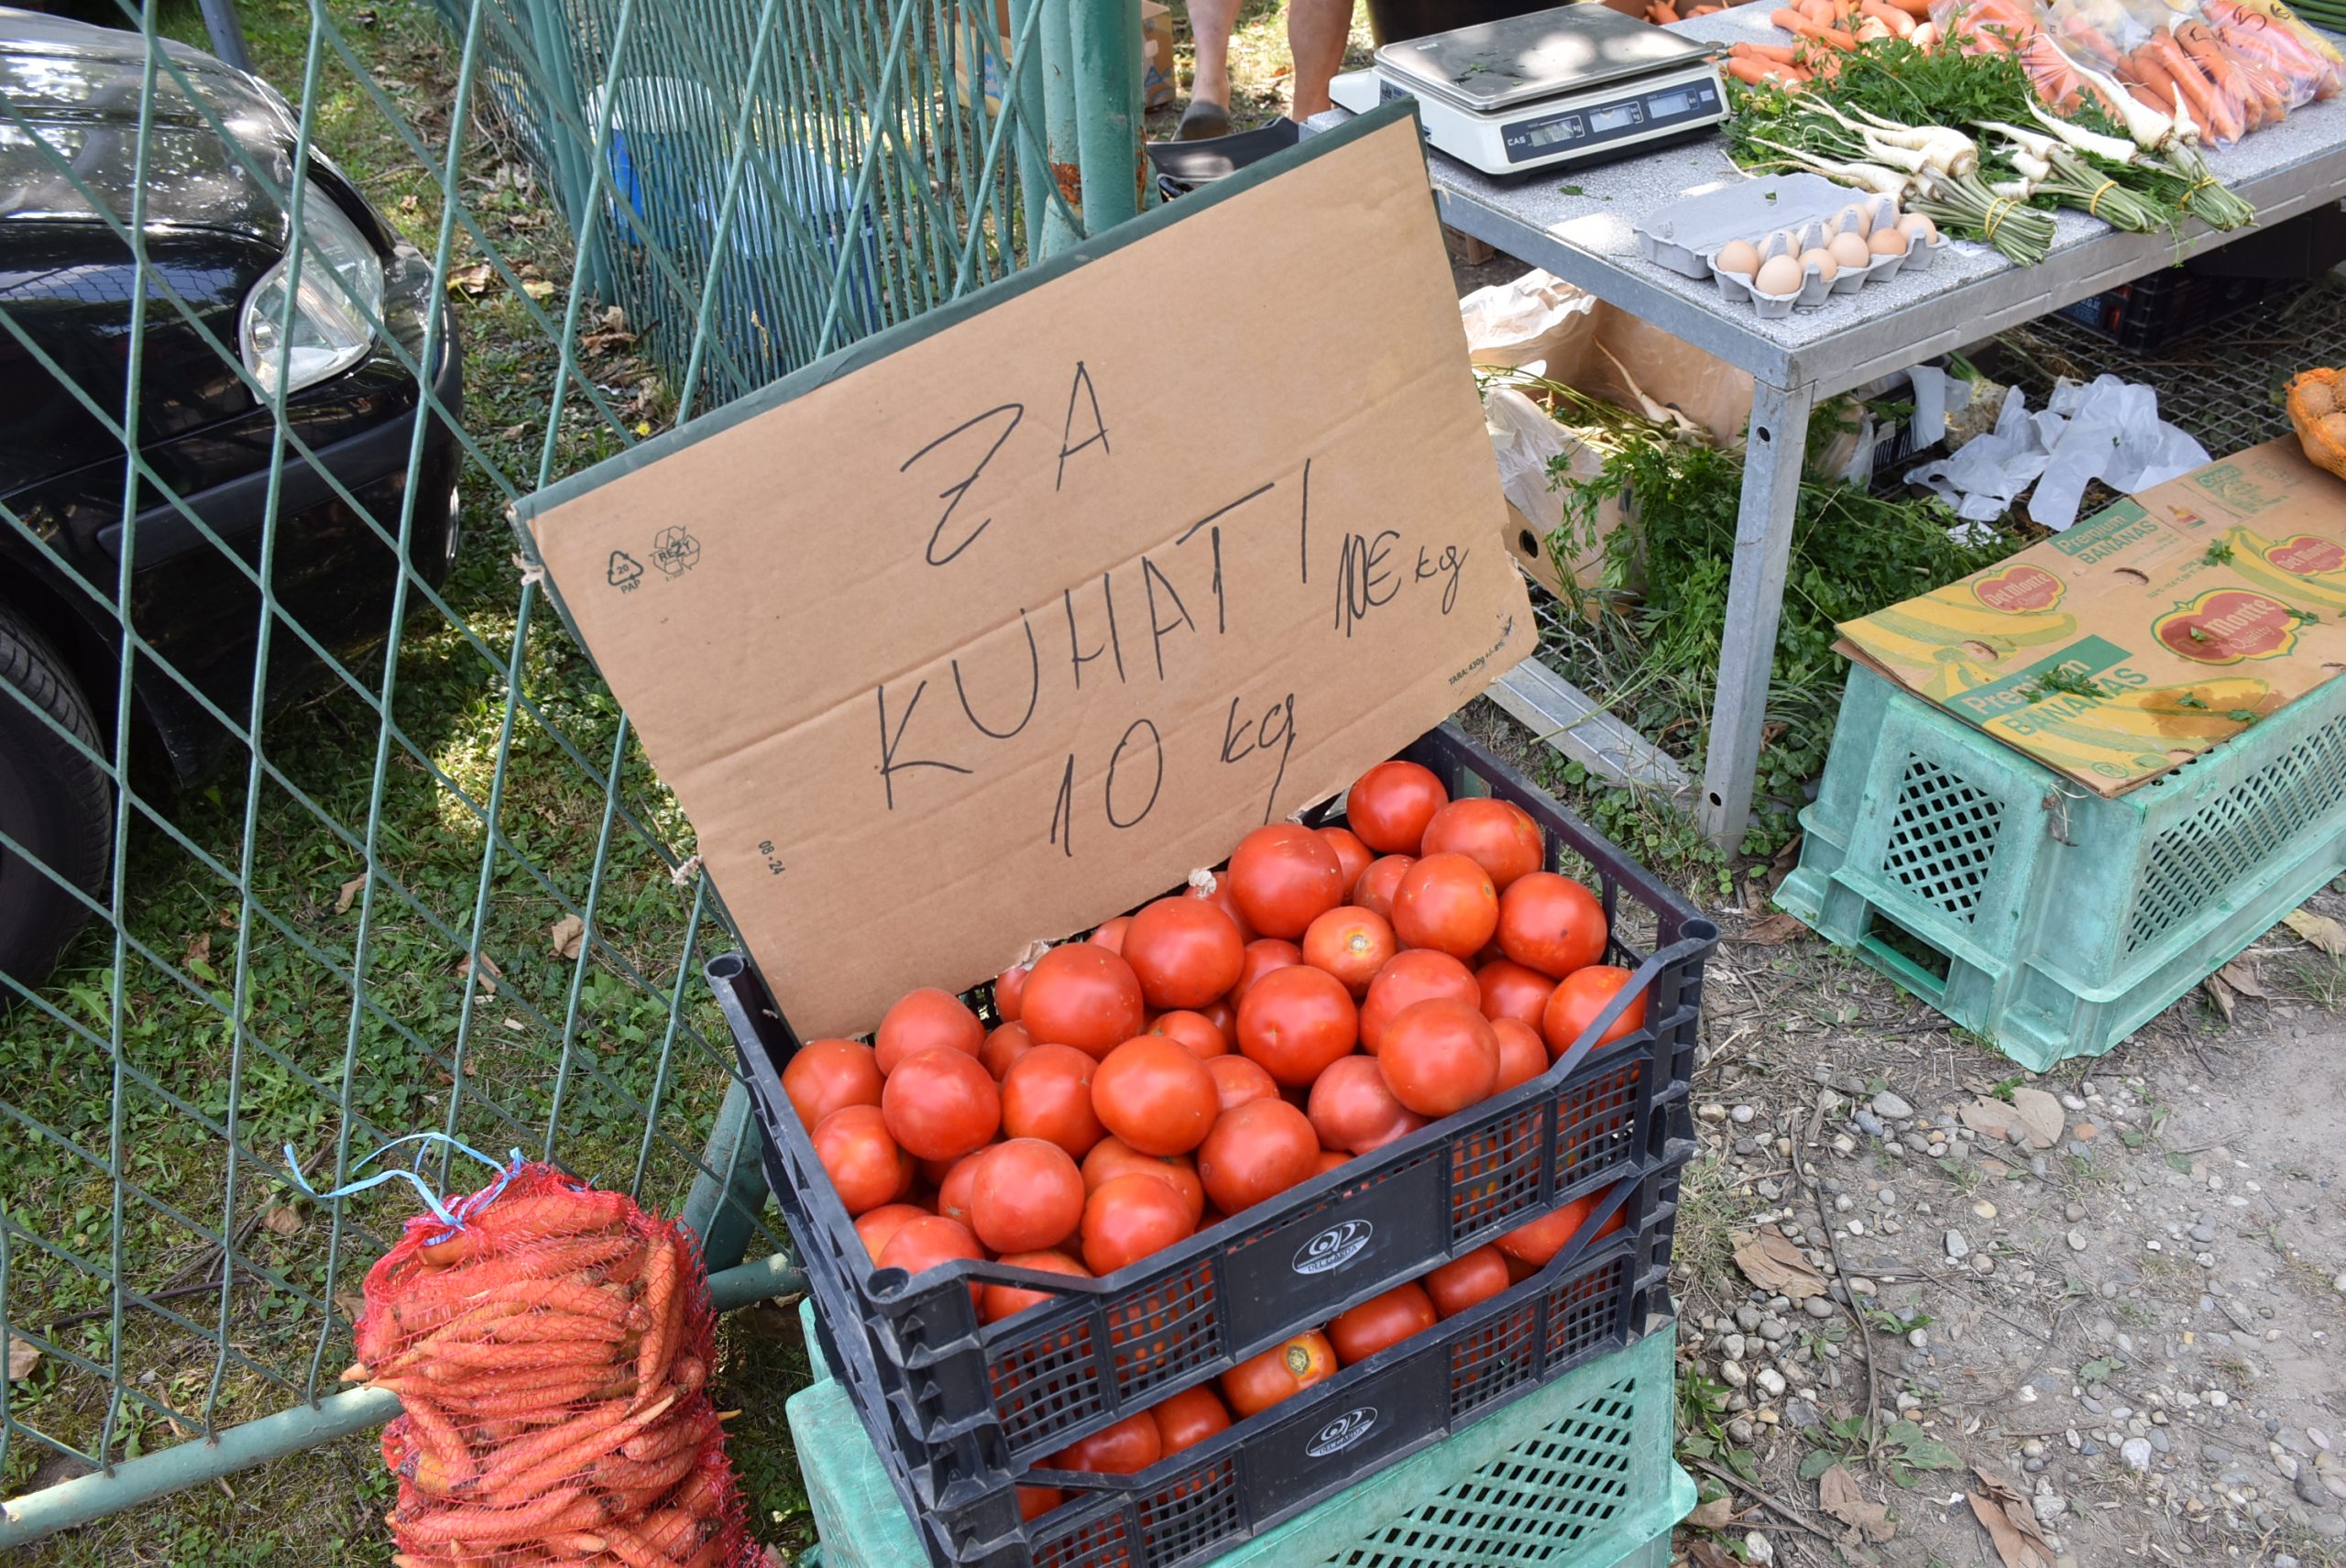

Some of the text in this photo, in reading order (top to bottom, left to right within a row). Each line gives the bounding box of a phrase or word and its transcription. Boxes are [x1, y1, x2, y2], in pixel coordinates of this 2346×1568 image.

[1507, 136, 1526, 147] CAS
[901, 360, 1110, 566] ZA
[2057, 515, 2128, 552] Premium
[2077, 521, 2159, 565] BANANAS
[658, 539, 690, 563] REZY
[616, 564, 630, 576] 20
[620, 578, 641, 594] PAP
[1415, 545, 1469, 615] kg
[1983, 587, 2012, 607] Del
[2005, 573, 2052, 597] Monte
[2202, 598, 2278, 637] Monte
[2228, 625, 2275, 650] Quality
[1448, 667, 1468, 685] TARA:
[1468, 654, 1485, 672] 430g
[1960, 659, 2092, 715] Premim
[1051, 693, 1297, 858] 10 kg
[1307, 1245, 1357, 1273] DEL GARDA
